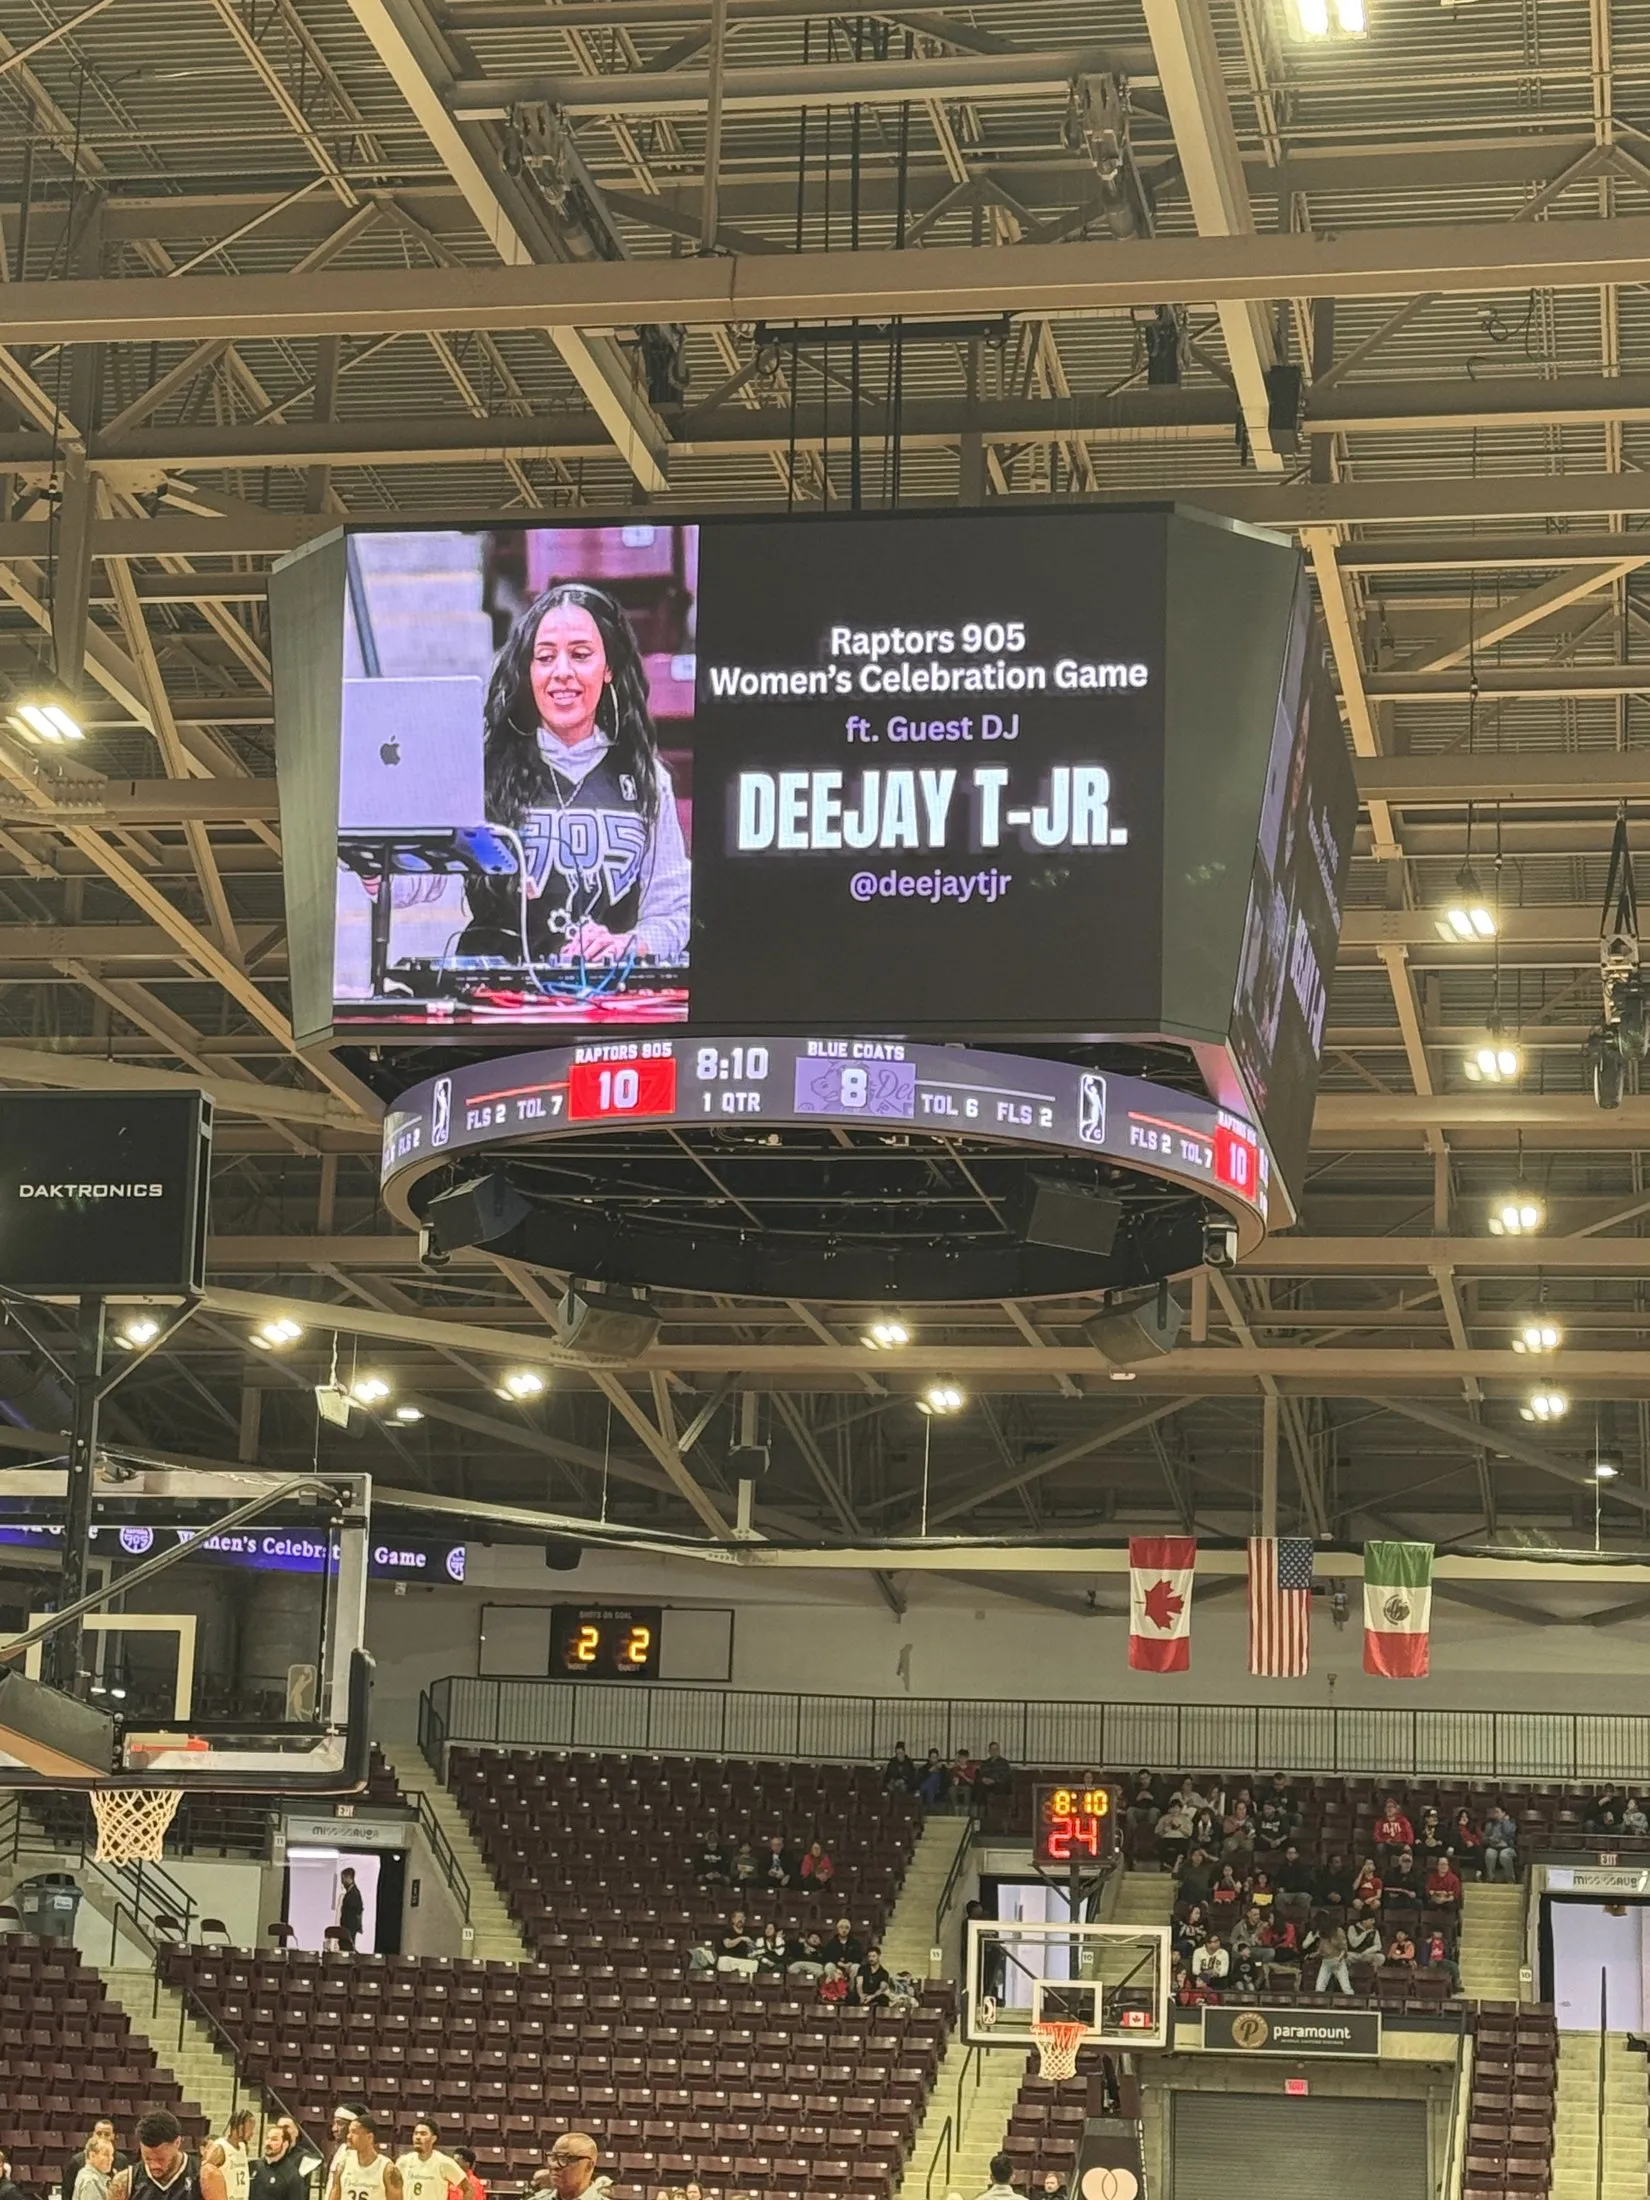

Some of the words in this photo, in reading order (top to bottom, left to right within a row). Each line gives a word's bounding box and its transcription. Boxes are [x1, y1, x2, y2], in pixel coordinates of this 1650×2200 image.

[830, 627, 955, 660] Raptors
[962, 622, 1026, 654] 905
[710, 665, 852, 696] Women's
[859, 661, 1046, 693] Celebration
[1054, 660, 1148, 689] Game
[845, 715, 879, 743] ft.
[888, 715, 973, 742] Guest
[981, 714, 1020, 741] DJ
[738, 768, 957, 850] DEEJAY
[974, 766, 1128, 848] T-JR.
[850, 868, 1012, 903] @deejaytjr
[575, 1044, 638, 1064] RAPTORS
[642, 1042, 672, 1060] 905
[696, 1047, 769, 1080] 8:10
[807, 1041, 848, 1058] BLUE
[853, 1043, 905, 1061] COATS
[599, 1069, 639, 1111] 10
[703, 1092, 712, 1113] 1
[722, 1092, 761, 1114] QTR
[841, 1068, 868, 1108] 8
[466, 1107, 491, 1131] FLS
[495, 1104, 506, 1124] 2
[517, 1098, 547, 1120] TOL
[551, 1095, 564, 1117] 7
[921, 1093, 959, 1117] TOL
[965, 1098, 979, 1119] 6
[997, 1102, 1033, 1126] FLS
[1039, 1107, 1053, 1129] 2
[1130, 1125, 1158, 1151] FLS
[1161, 1133, 1172, 1155] 2
[1180, 1139, 1203, 1166] TOL
[1205, 1149, 1213, 1169] 7
[1229, 1142, 1247, 1186] 10
[18, 1183, 164, 1199] DAKTRONICS
[176, 1530, 257, 1554] Wmen's
[374, 1546, 427, 1568] Game
[578, 1625, 600, 1661] 2
[628, 1626, 650, 1663] 2
[1054, 1789, 1109, 1817] 8:10
[1048, 1816, 1098, 1859] 24
[1273, 2026, 1351, 2041] paramount
[236, 2171, 246, 2186] 12
[413, 2182, 423, 2196] 8
